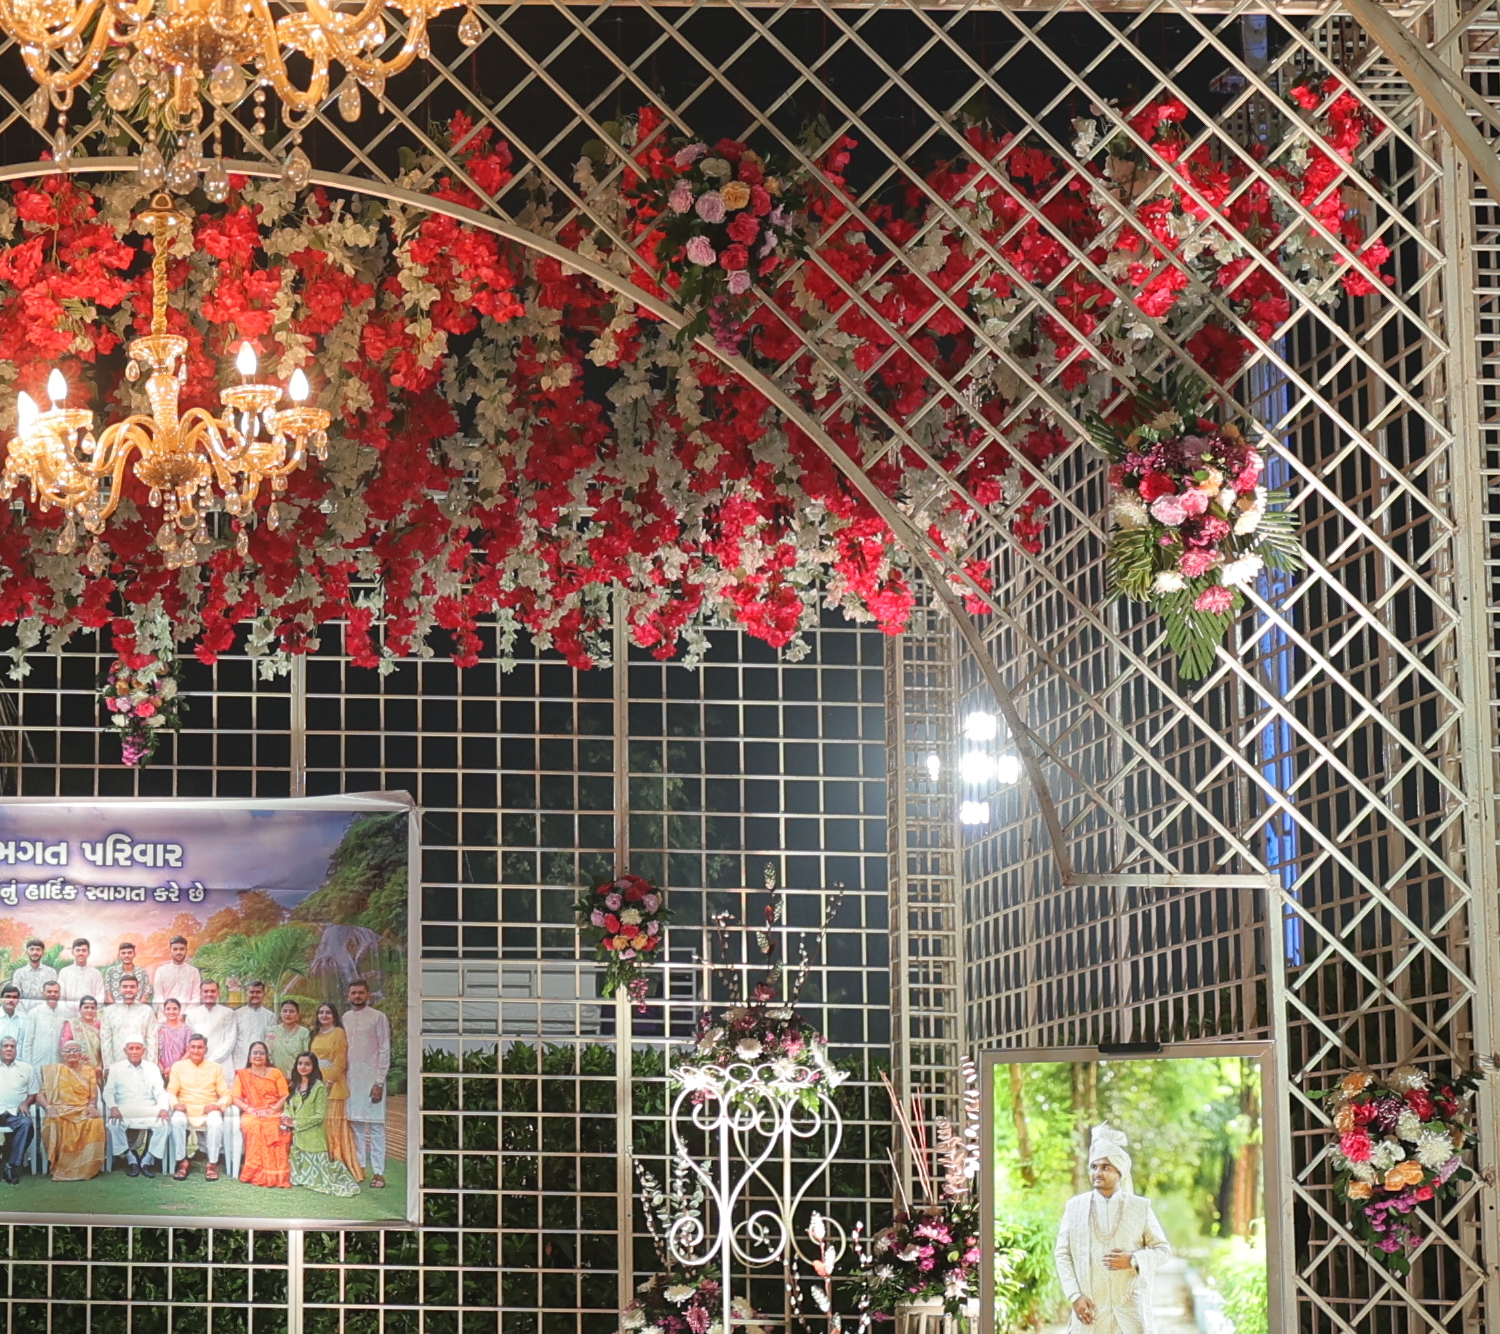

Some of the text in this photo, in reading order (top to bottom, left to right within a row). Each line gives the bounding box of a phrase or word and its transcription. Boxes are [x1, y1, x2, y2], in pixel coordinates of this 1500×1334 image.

[81, 832, 183, 868] પરિવાર
[25, 877, 78, 901] હાર્દિક
[85, 886, 146, 902] સ્વાગત
[153, 881, 180, 903] કરે
[188, 881, 205, 903] છે
